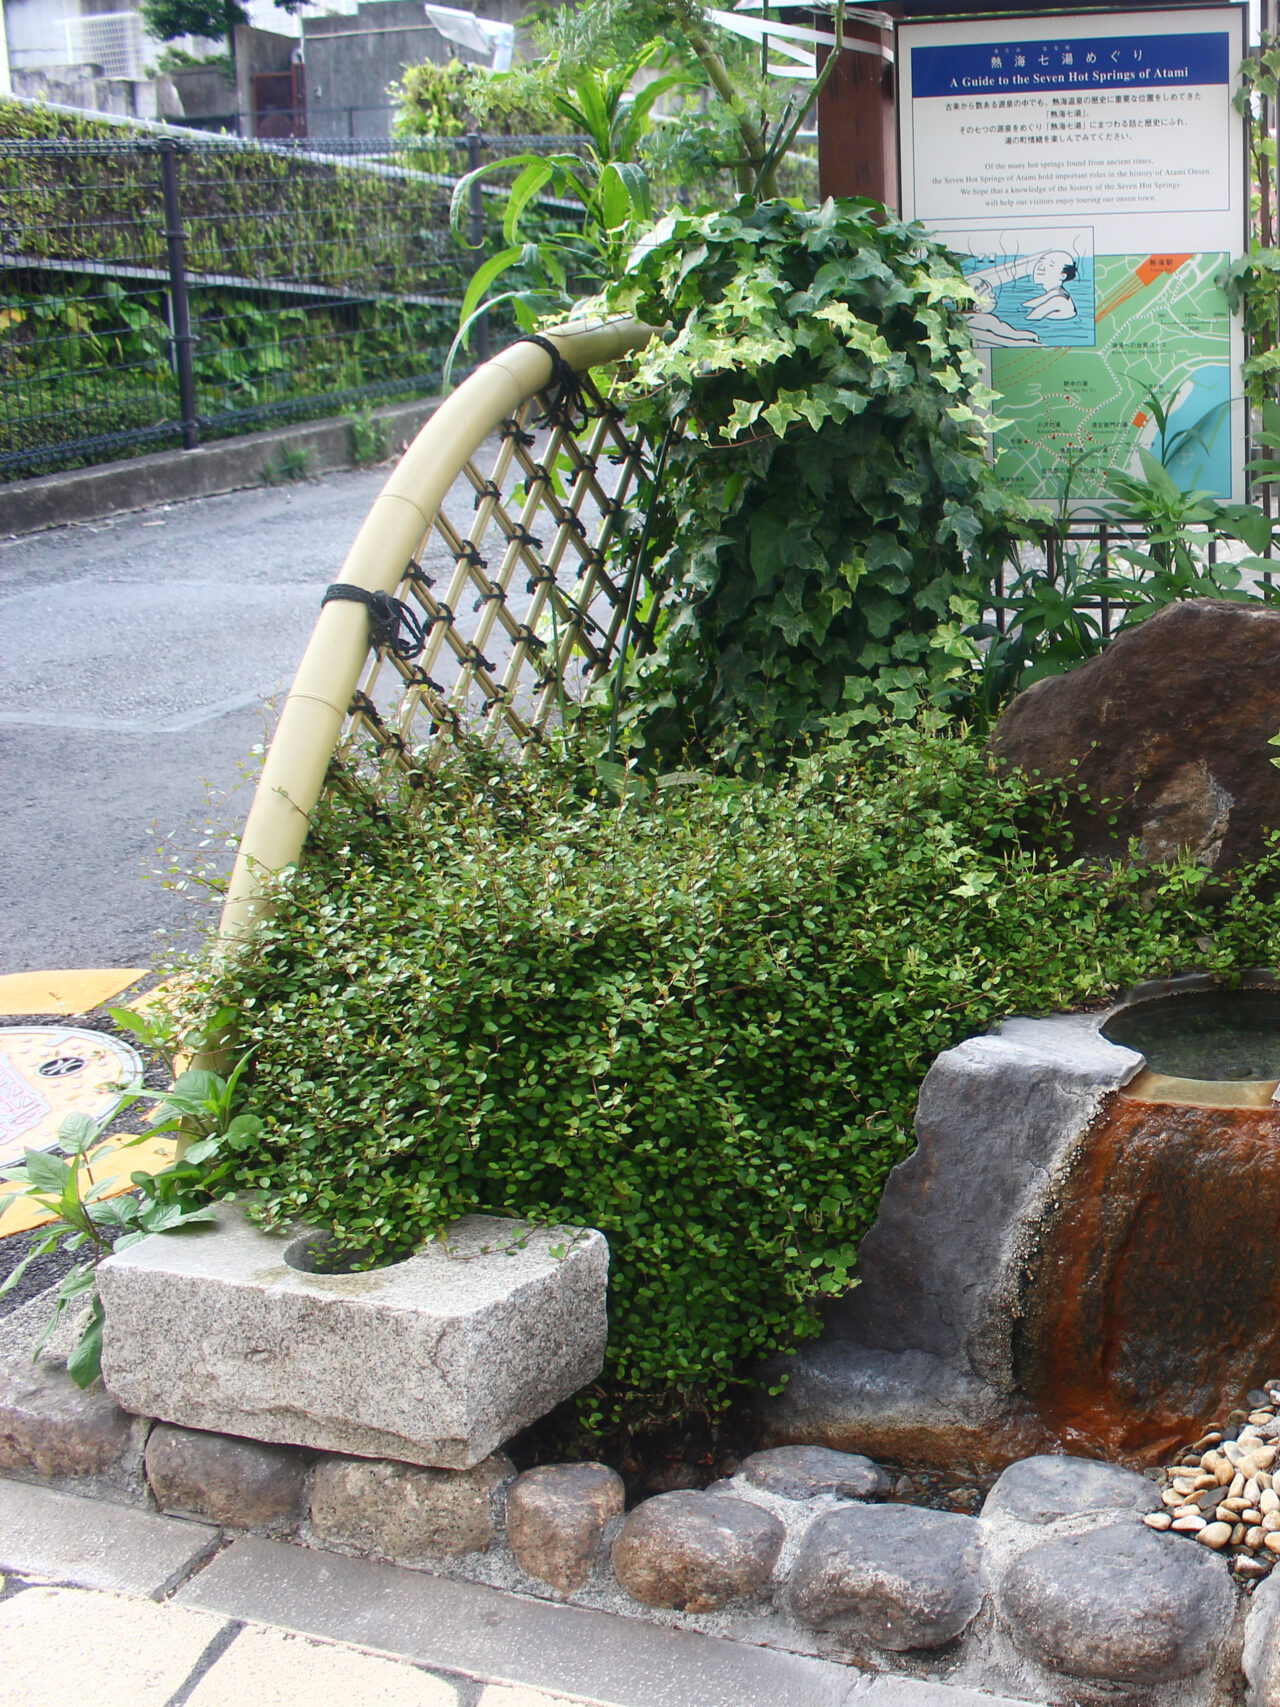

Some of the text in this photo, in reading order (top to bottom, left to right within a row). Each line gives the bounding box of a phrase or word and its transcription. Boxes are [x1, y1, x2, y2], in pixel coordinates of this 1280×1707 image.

[990, 50, 1142, 69] 熱海七湯めぐり
[950, 67, 1188, 88] A Guide to the Seven Hot Springs of Atami
